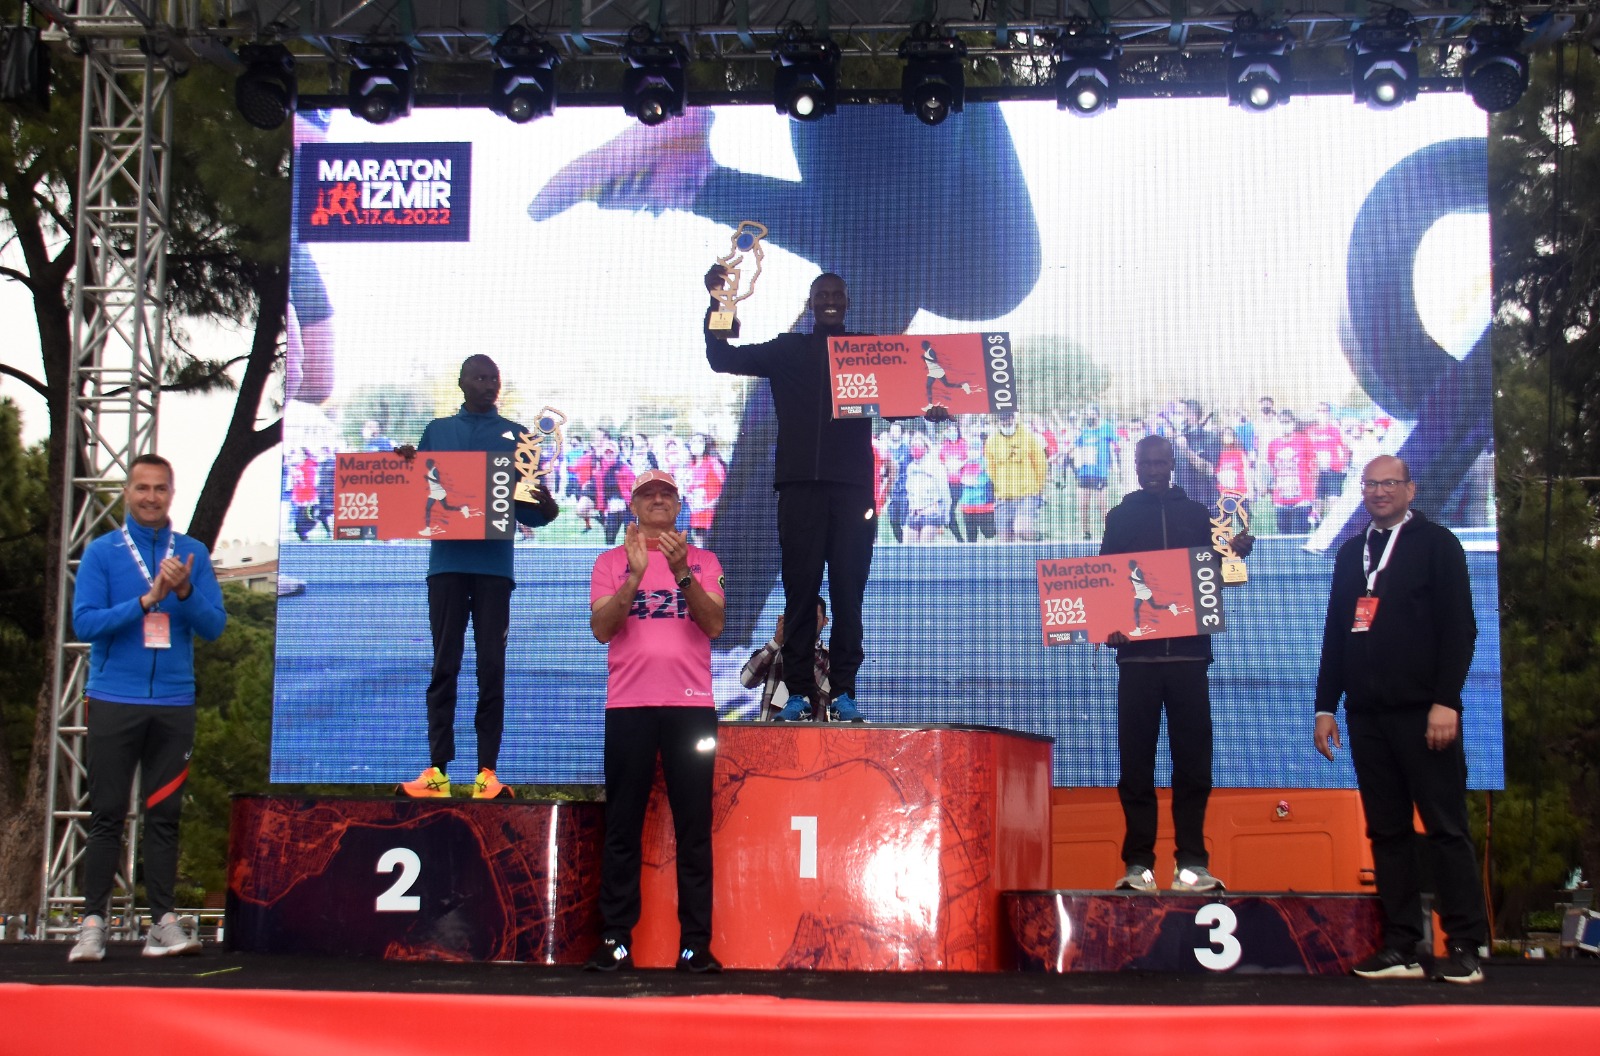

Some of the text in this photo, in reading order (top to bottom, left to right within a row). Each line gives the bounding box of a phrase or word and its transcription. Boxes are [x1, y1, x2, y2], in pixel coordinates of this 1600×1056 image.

[318, 159, 452, 182] MARATON
[834, 340, 910, 354] Maraton,
[835, 352, 908, 370] yeniden.
[836, 385, 879, 399] 2022
[340, 470, 411, 489] yeniden.
[492, 456, 511, 532] 4.000 $
[337, 505, 379, 520] 2022
[1041, 562, 1118, 577] Maraton,
[1043, 575, 1115, 595] yeniden.
[1195, 551, 1220, 626] 3.000 $
[1045, 610, 1087, 626] 2022
[790, 815, 818, 879] 1
[375, 847, 422, 911] 2
[1193, 903, 1242, 971] 3
